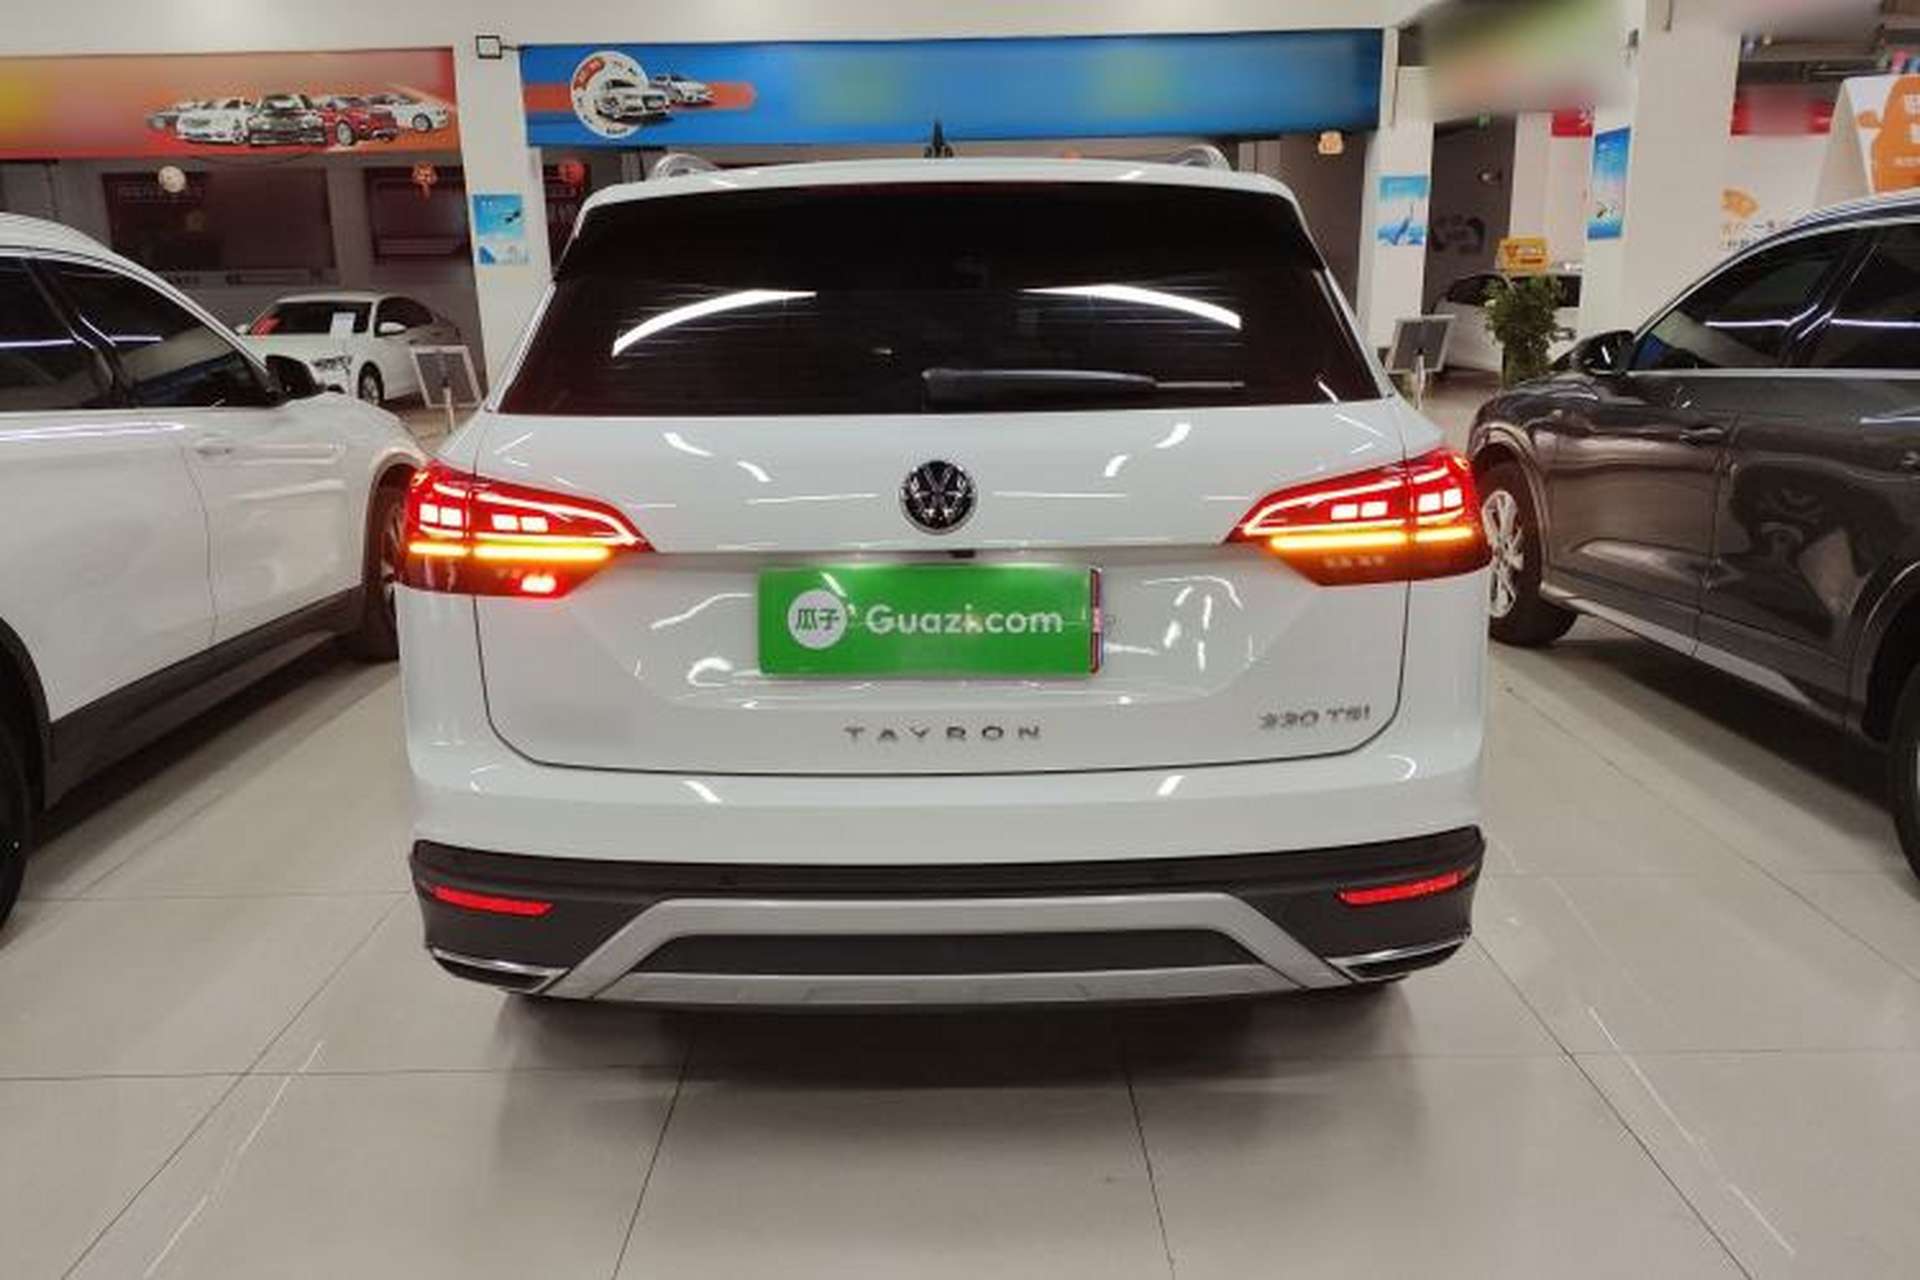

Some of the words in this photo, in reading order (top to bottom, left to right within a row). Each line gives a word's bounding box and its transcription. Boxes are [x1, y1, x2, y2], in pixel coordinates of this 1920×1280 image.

[795, 607, 840, 631] 瓜子
[865, 603, 1064, 634] Guazi.com
[1325, 704, 1370, 723] TSI
[843, 724, 1041, 742] TAYRON
